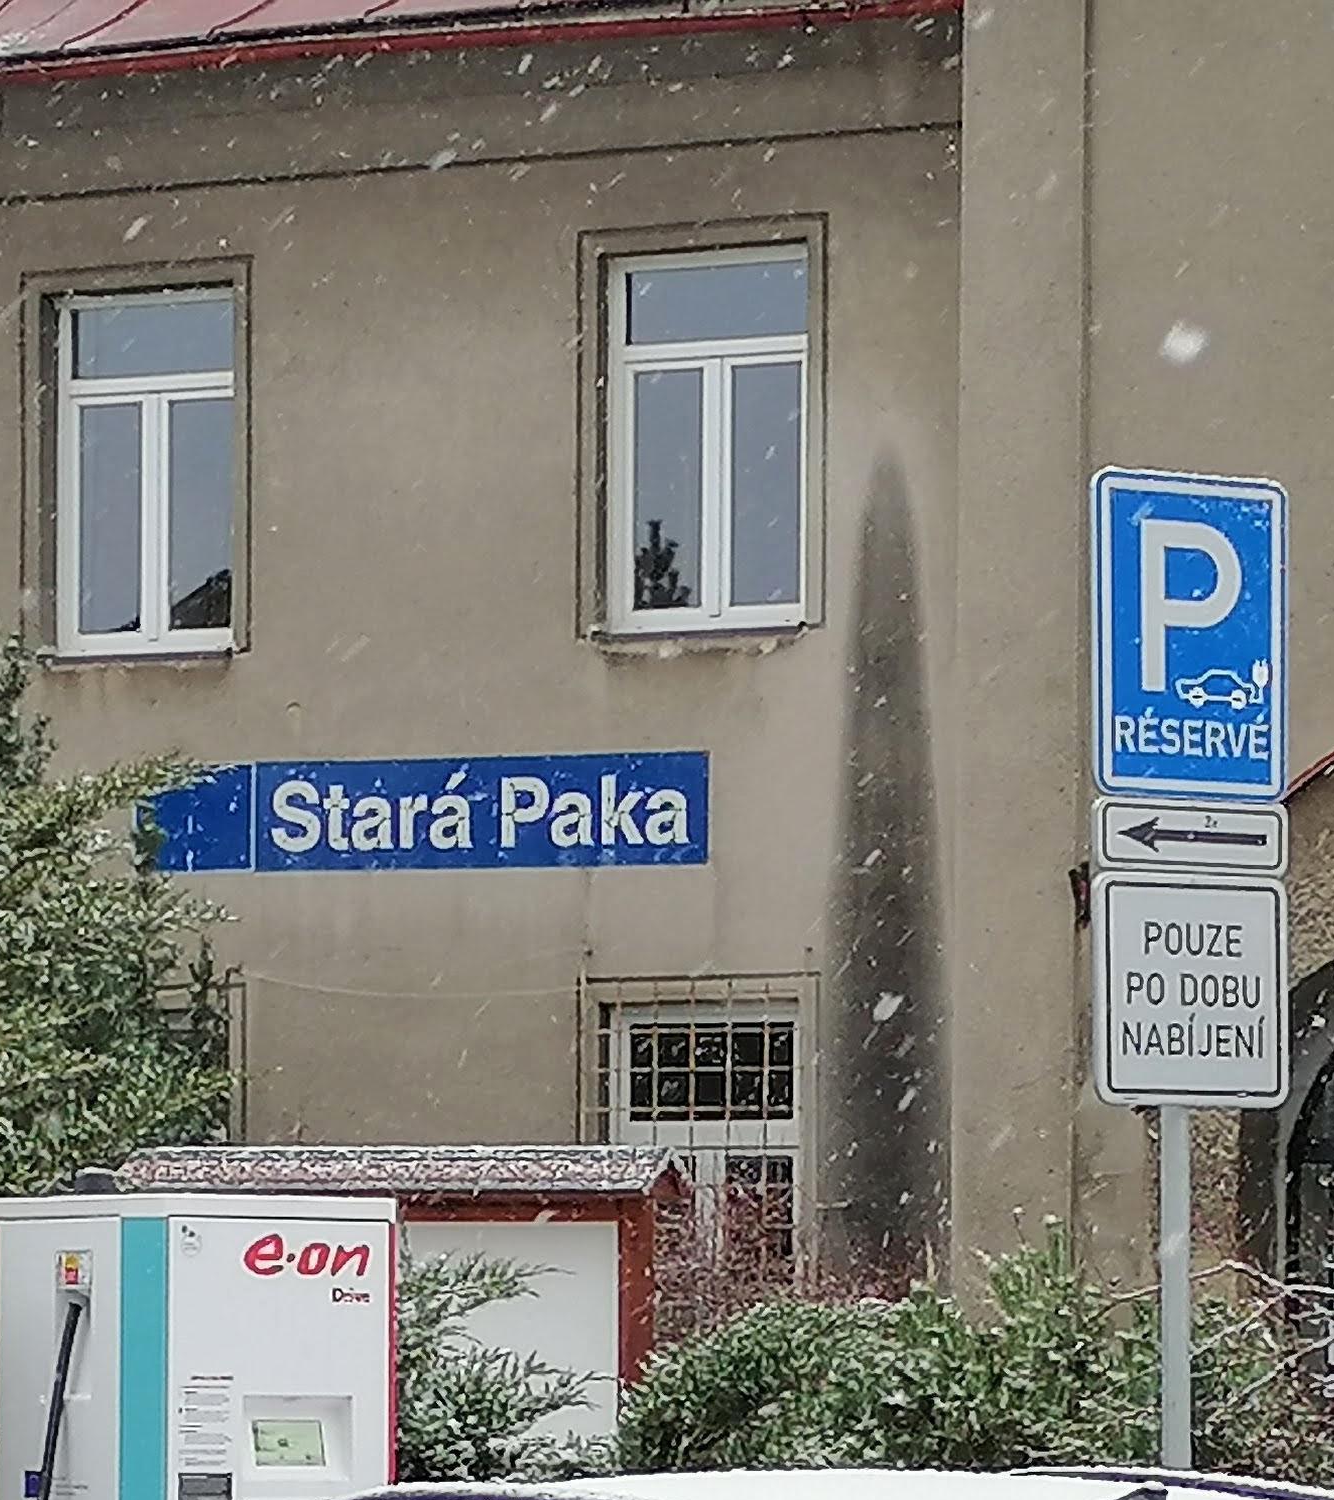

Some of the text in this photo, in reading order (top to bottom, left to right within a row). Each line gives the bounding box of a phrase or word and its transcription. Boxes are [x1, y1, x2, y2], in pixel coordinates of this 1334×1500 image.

[1141, 518, 1242, 692] P
[1114, 706, 1269, 760] RÉSERVÉ
[271, 768, 689, 852] Stará Paka
[1143, 921, 1243, 958] POUZE
[1126, 971, 1261, 1009] PO DOBU
[1122, 1012, 1265, 1059] NABÍJENÍ
[331, 1287, 370, 1303] Drive
